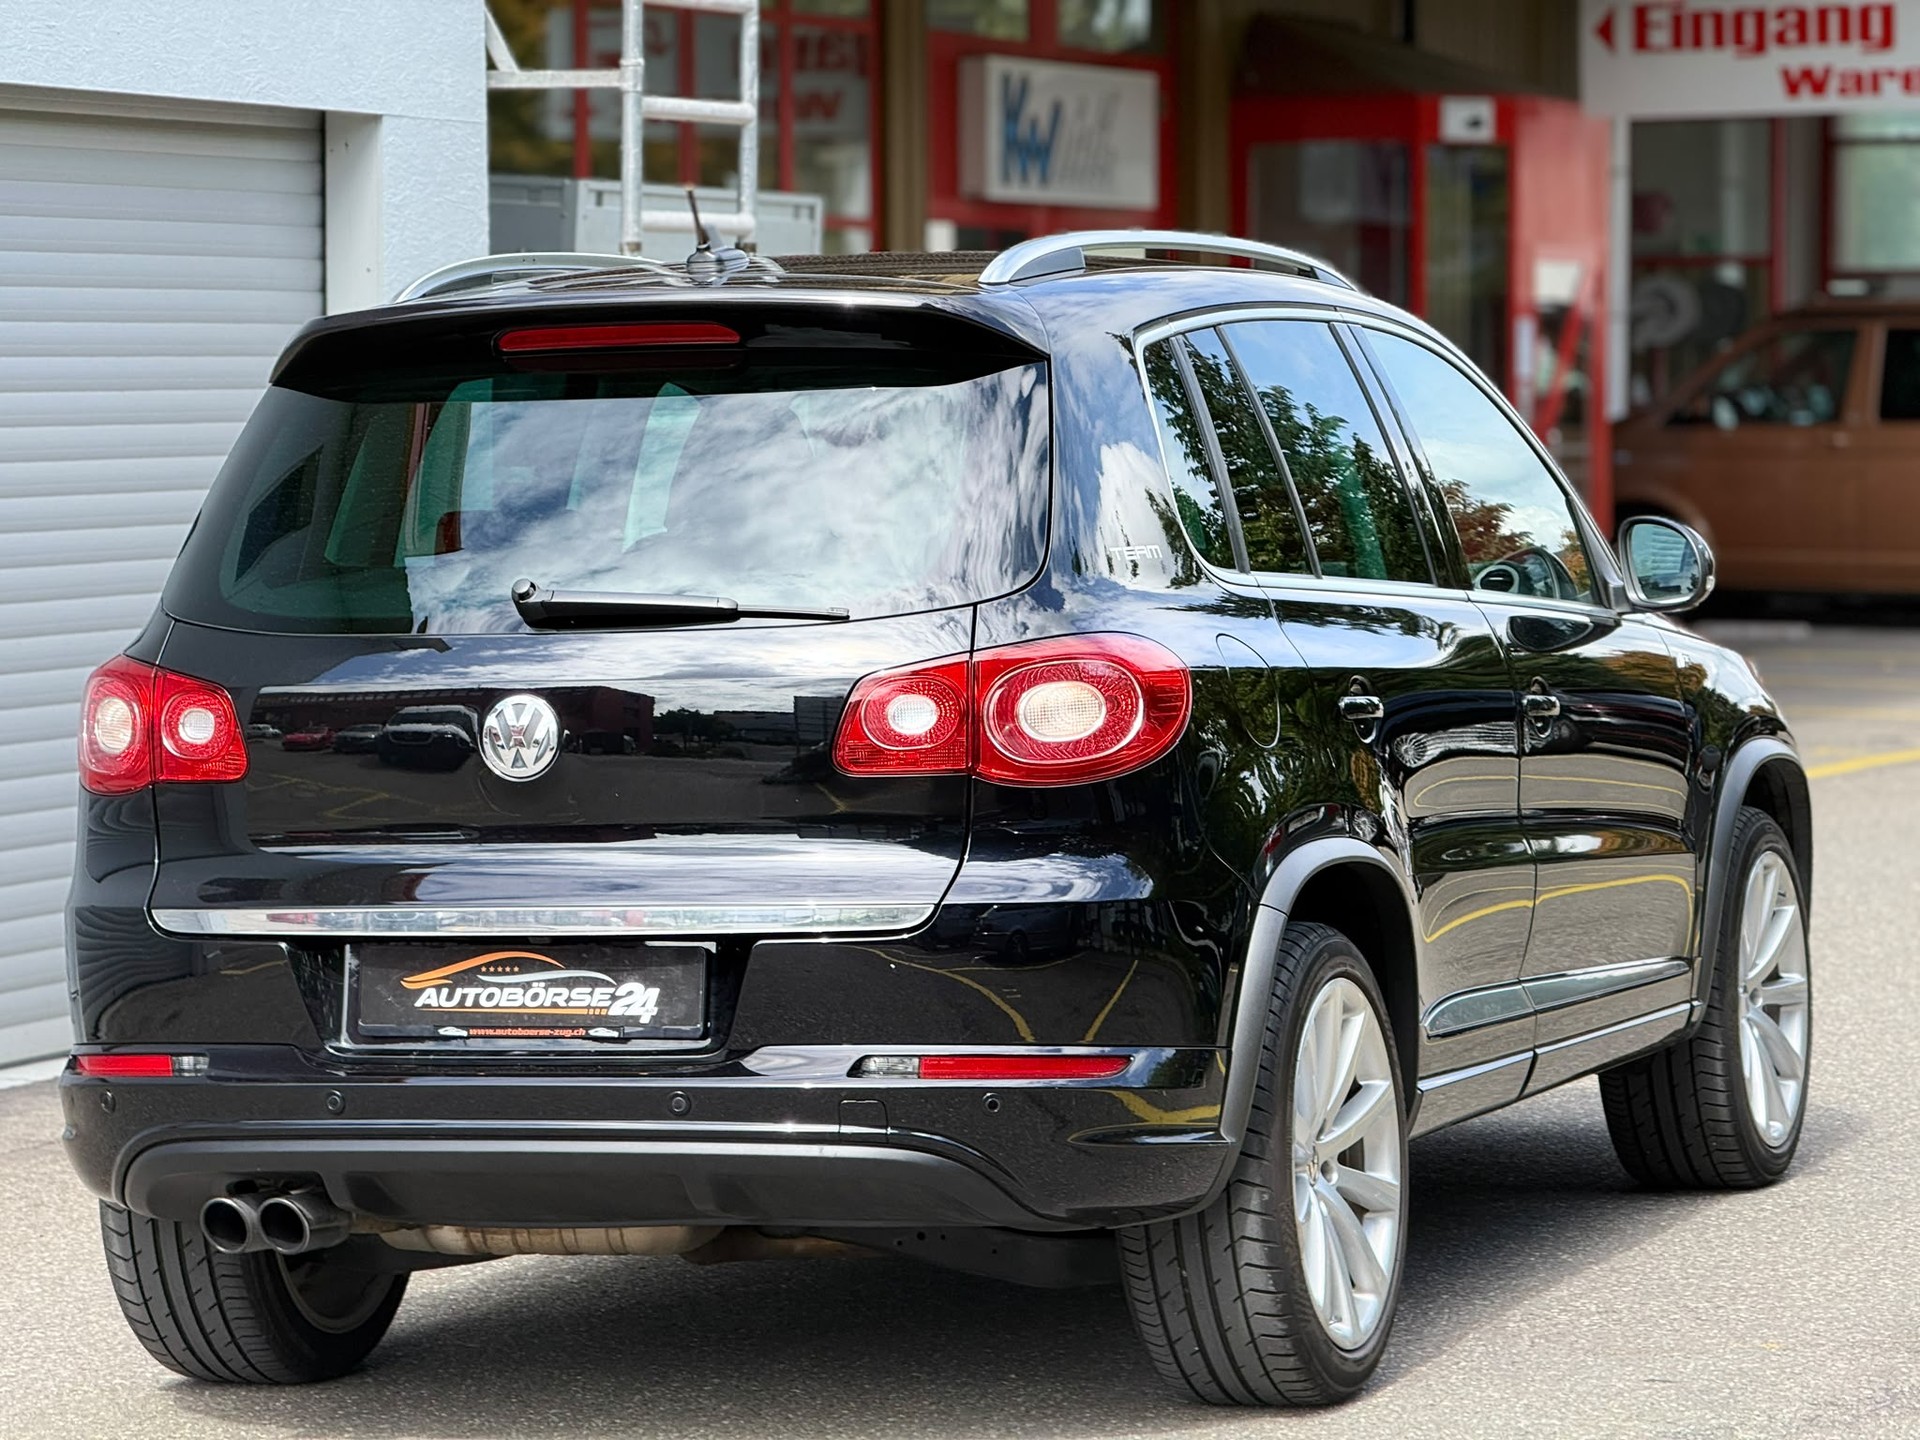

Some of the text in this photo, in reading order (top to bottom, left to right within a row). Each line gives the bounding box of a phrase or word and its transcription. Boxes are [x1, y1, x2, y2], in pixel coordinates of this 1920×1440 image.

[1633, 1, 1895, 58] Eingang
[1109, 544, 1163, 560] TEAM
[469, 1027, 586, 1037] www.autoboerse-zug.ch
